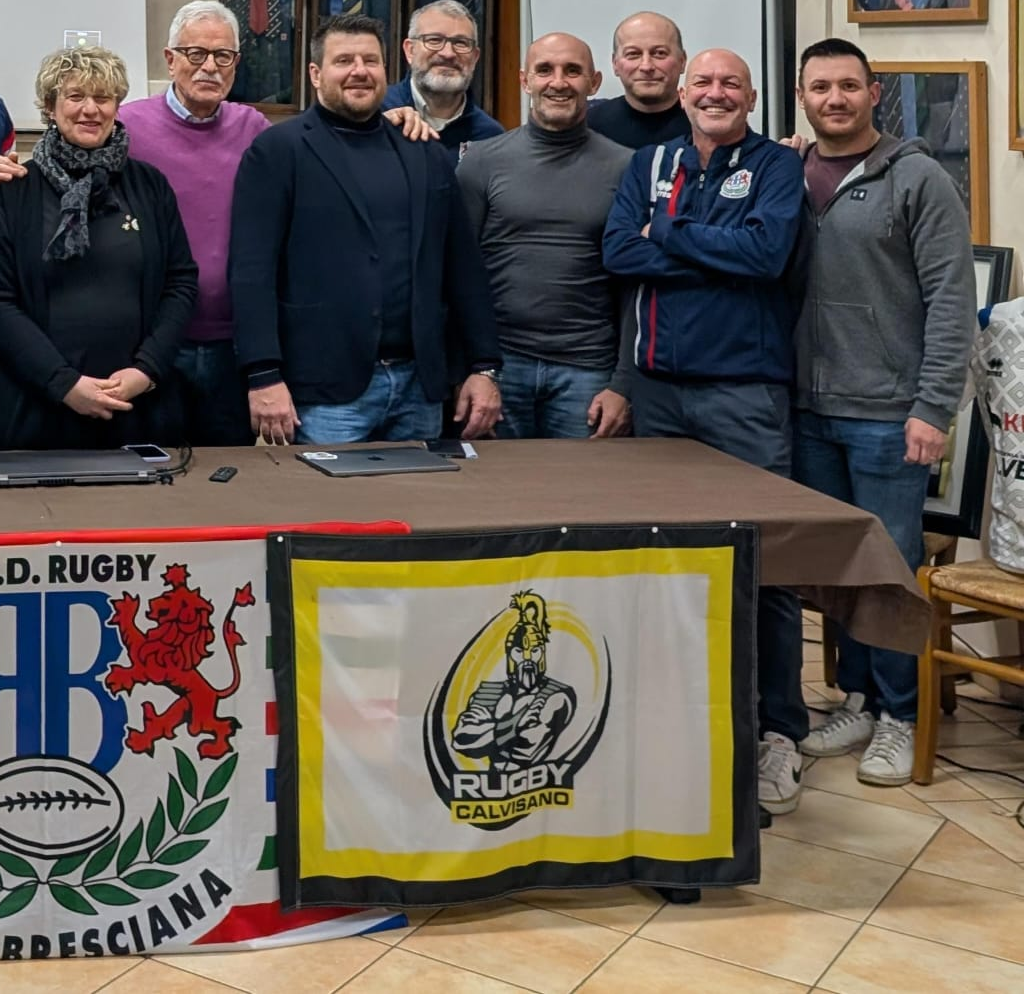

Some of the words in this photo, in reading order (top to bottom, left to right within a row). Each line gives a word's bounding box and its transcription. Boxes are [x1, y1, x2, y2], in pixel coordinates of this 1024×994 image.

[48, 554, 158, 583] RUGBY
[453, 763, 573, 799] RUGBY
[455, 791, 570, 820] CALVISANO
[1, 867, 234, 961] BRESCIANA
